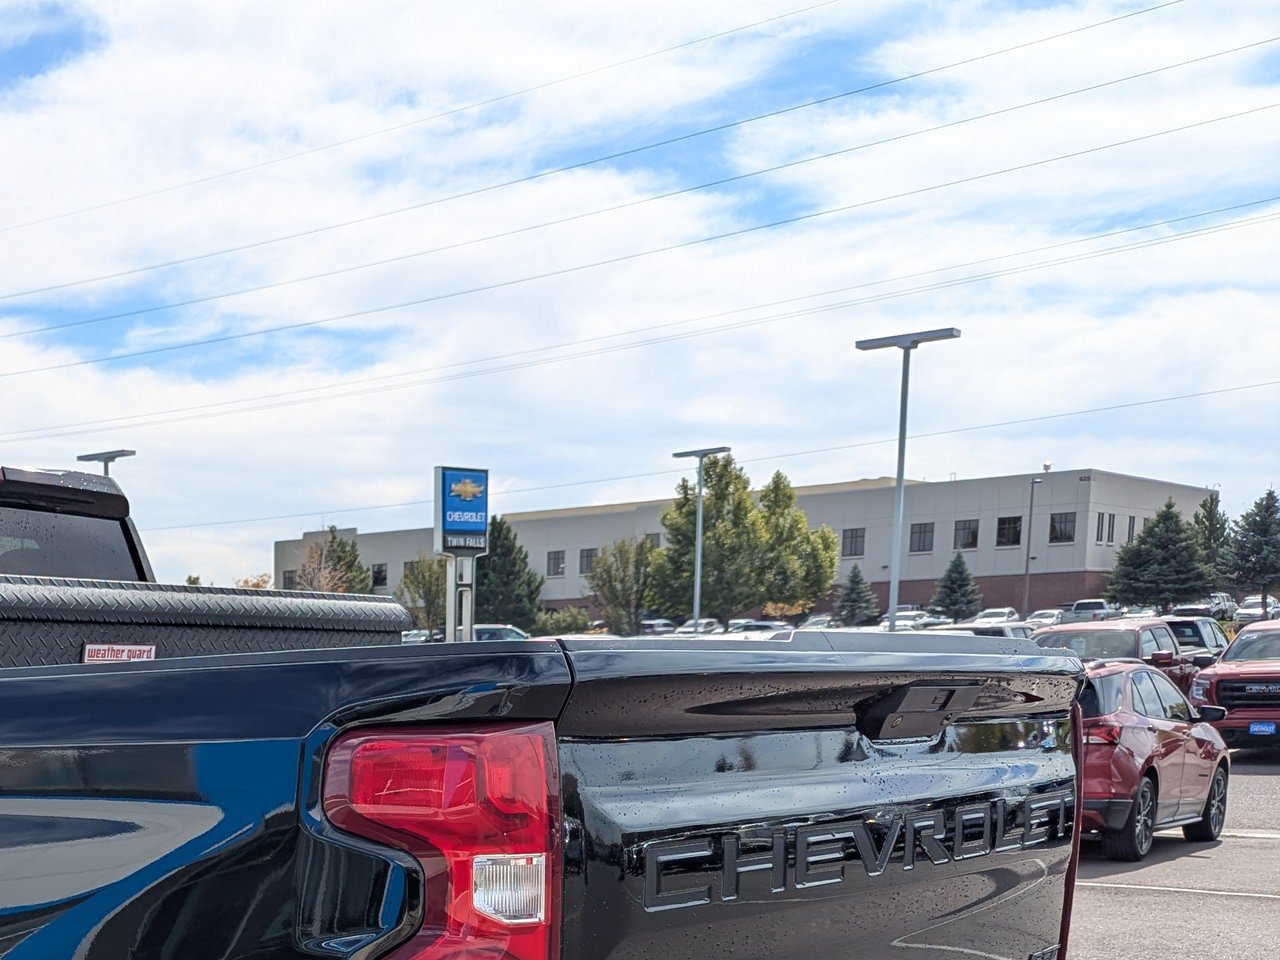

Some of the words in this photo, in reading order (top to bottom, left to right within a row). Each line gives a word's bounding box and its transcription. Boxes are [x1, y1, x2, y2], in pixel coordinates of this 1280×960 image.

[446, 511, 486, 523] CHEVROLET
[447, 537, 464, 547] TWIN
[465, 537, 486, 548] FALLS
[87, 642, 125, 659] weather
[127, 647, 153, 660] guard
[644, 788, 1073, 912] CHEVROLET
